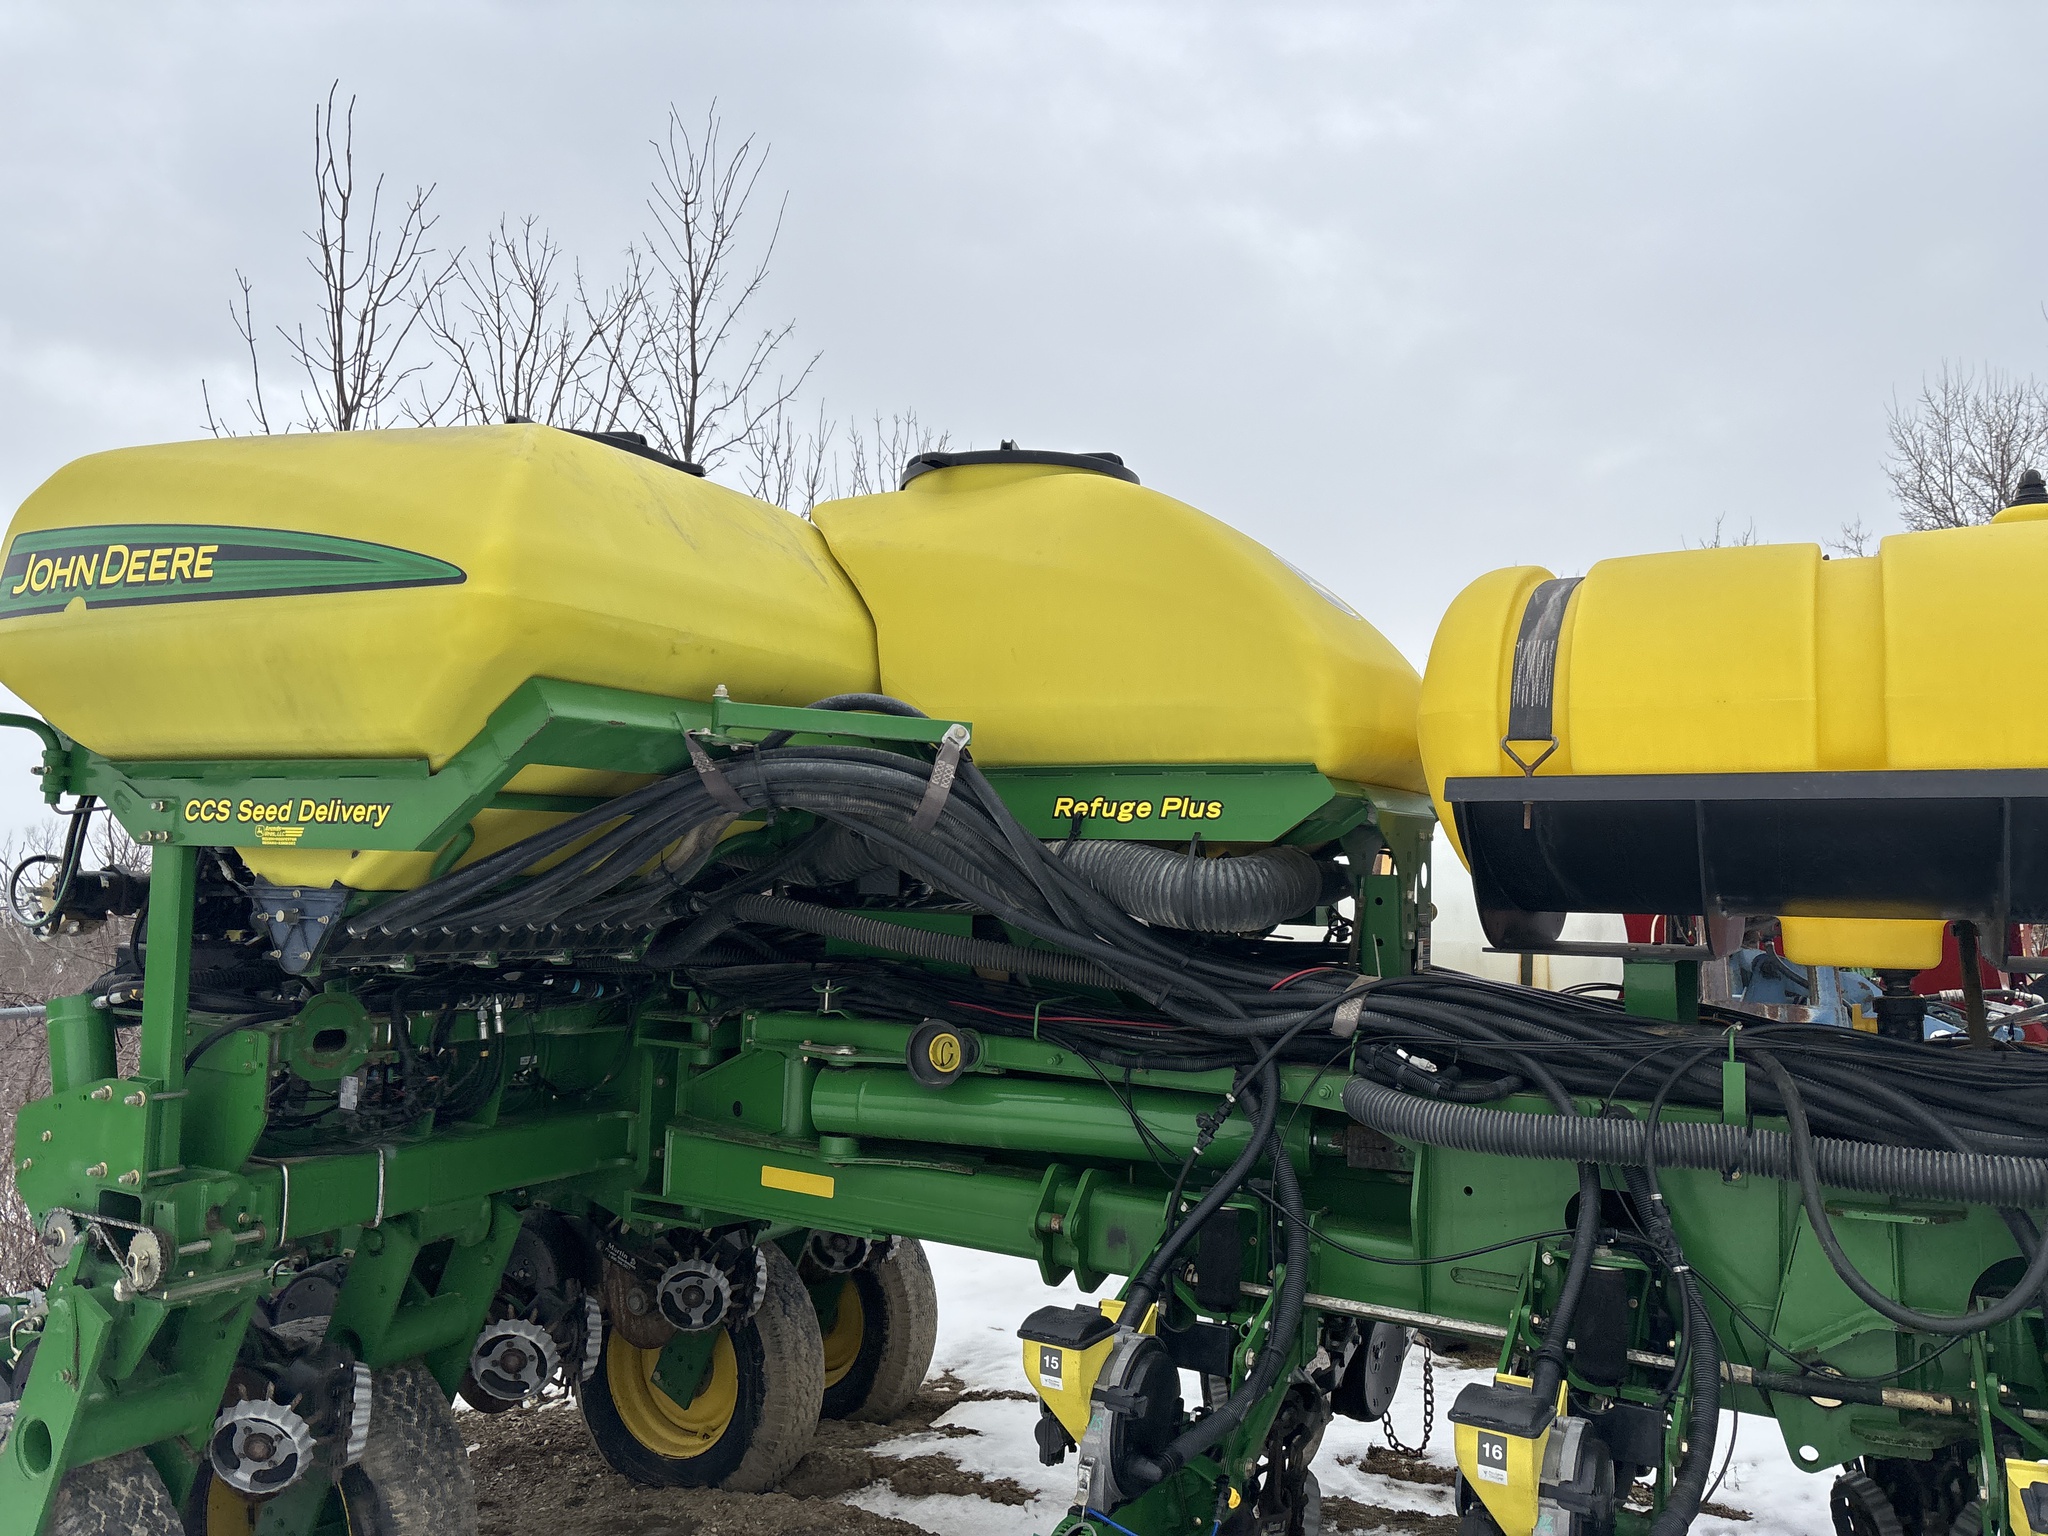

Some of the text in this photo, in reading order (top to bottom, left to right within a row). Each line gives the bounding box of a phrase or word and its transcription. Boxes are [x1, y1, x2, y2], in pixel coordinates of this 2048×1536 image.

[12, 544, 219, 595] JOHN DEERE
[184, 798, 392, 828] CCS Seed Delivery
[1053, 796, 1223, 822] Refuge Plus
[1043, 1354, 1059, 1370] 15
[1482, 1442, 1503, 1460] 16
